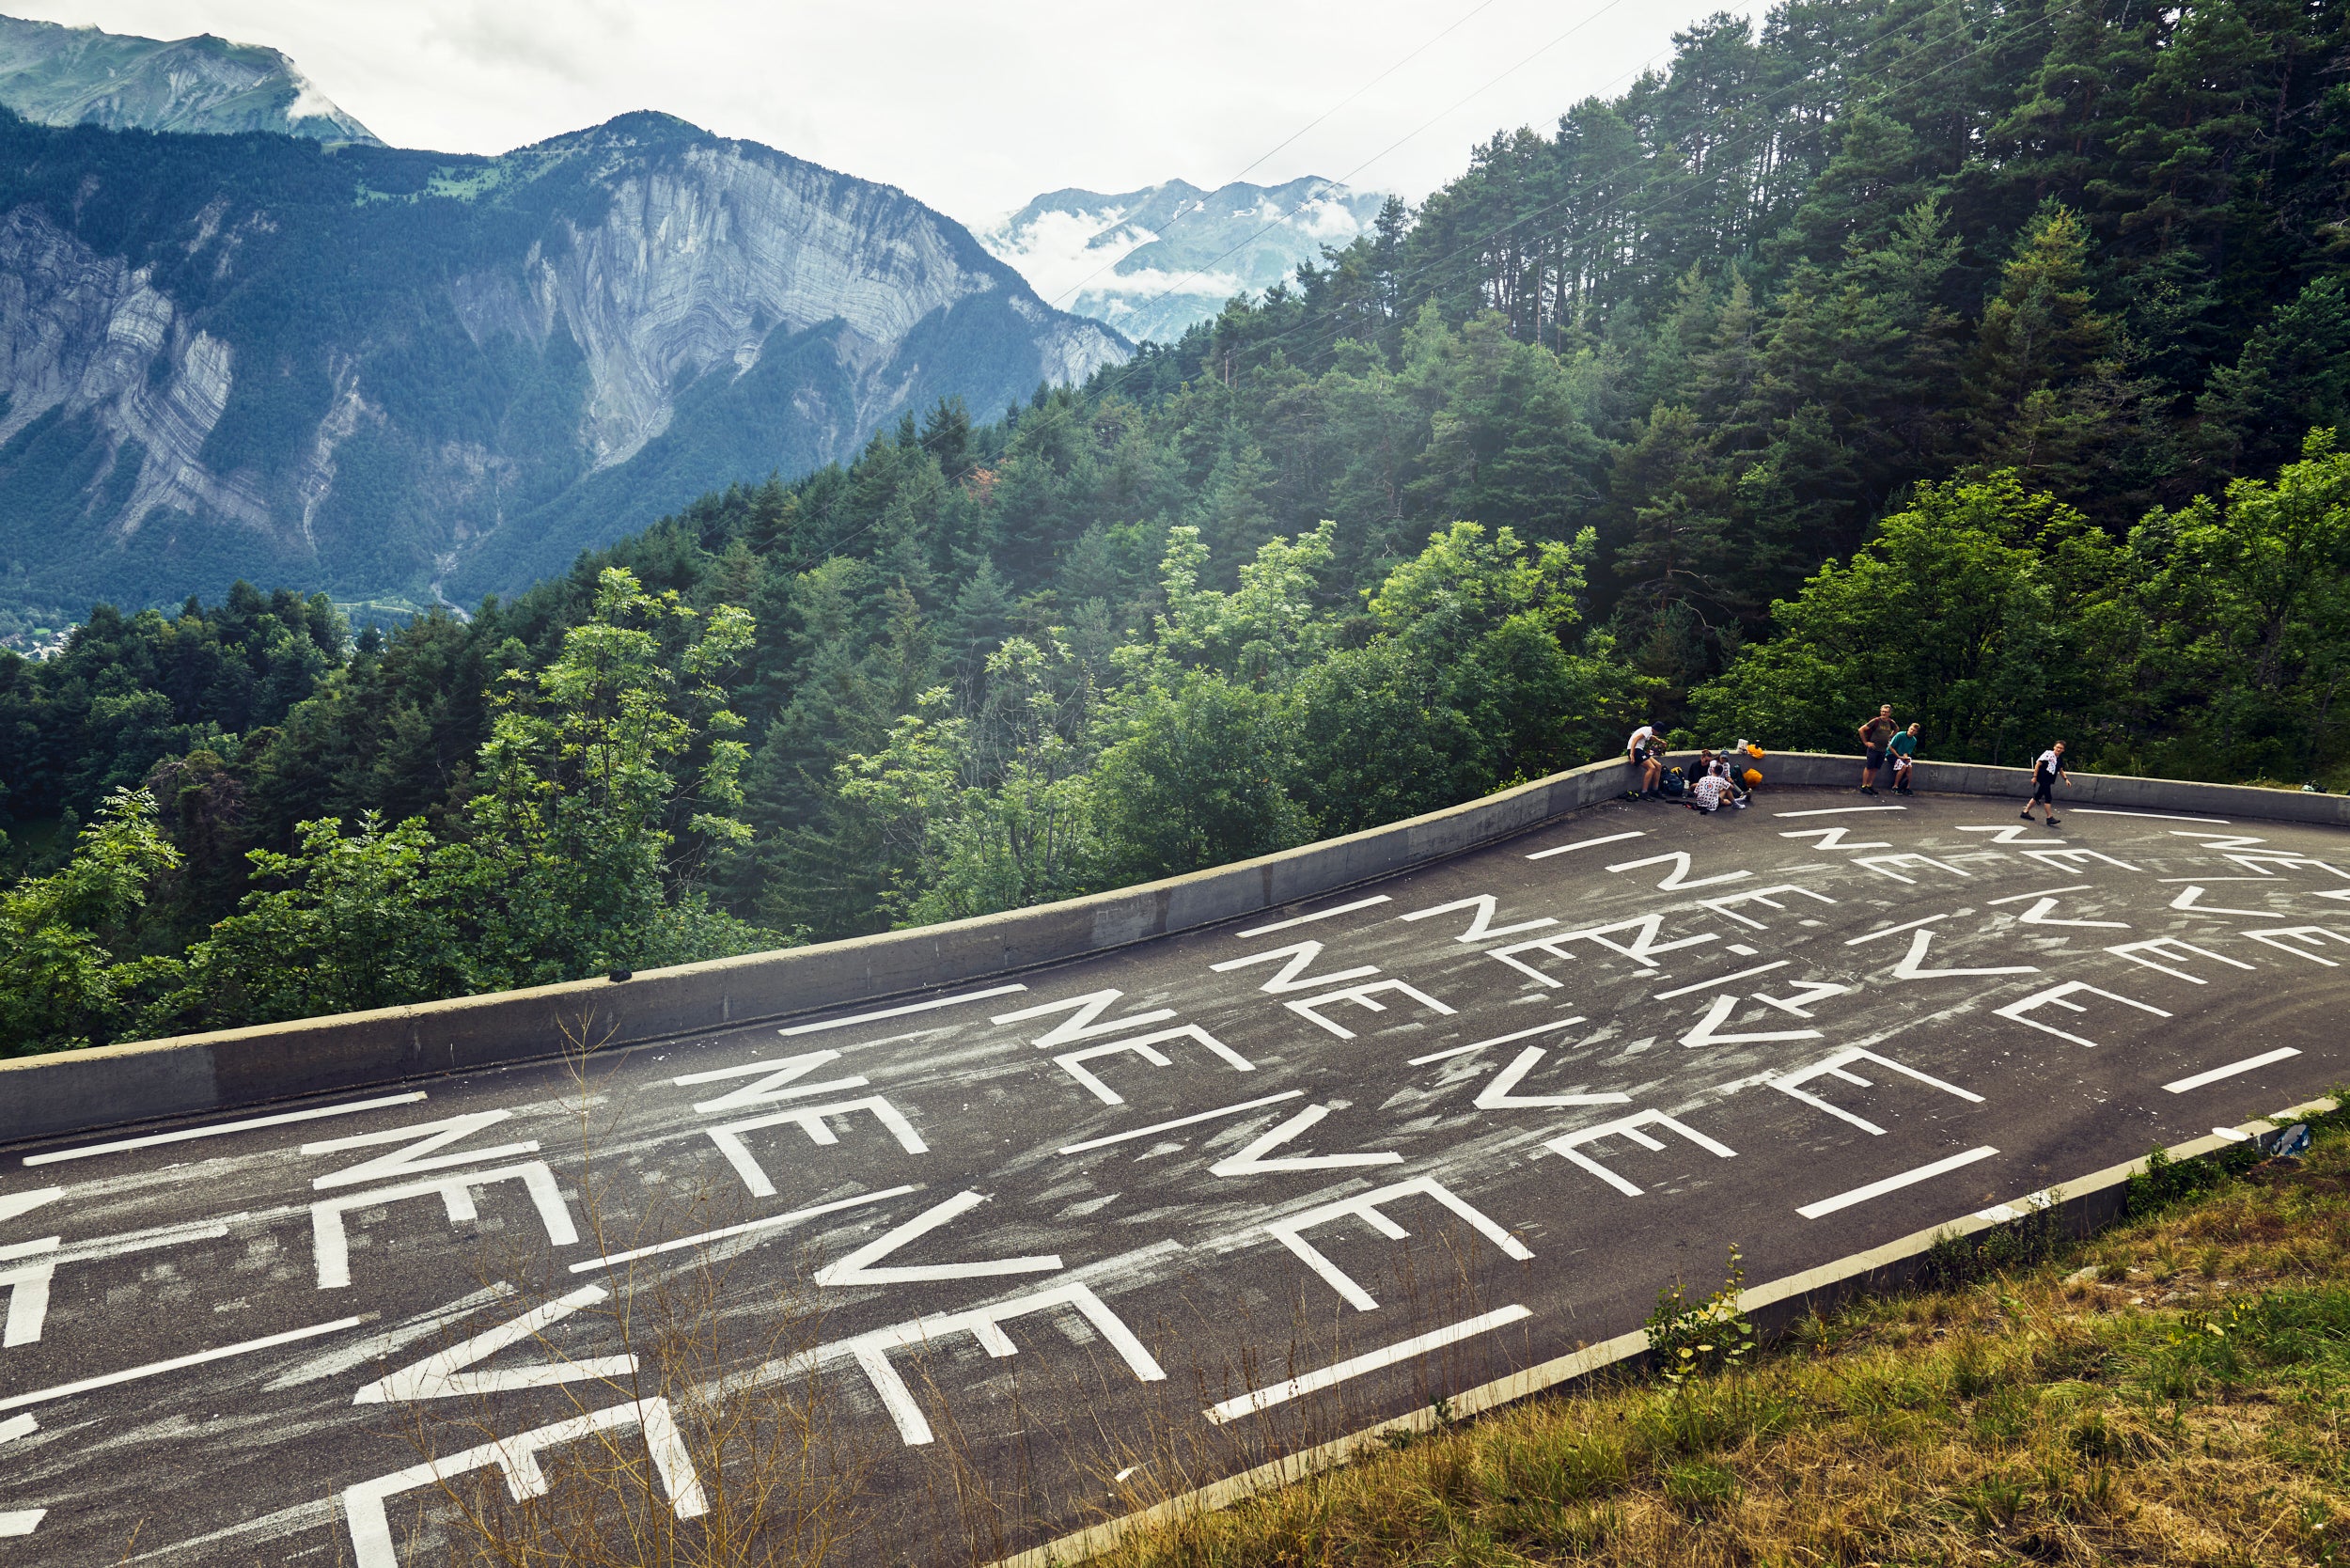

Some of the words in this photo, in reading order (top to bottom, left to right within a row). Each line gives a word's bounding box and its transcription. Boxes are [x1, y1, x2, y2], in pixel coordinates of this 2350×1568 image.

[1395, 894, 1985, 1136] NEVE
[1605, 851, 2173, 1047] NEVE
[1778, 827, 2256, 984] NEVE
[1955, 825, 2350, 966] NEVE
[991, 989, 1535, 1311] NEVE
[1209, 940, 1738, 1197] NEVE
[301, 1109, 711, 1568] NEVE
[672, 1049, 1166, 1446] NEVE
